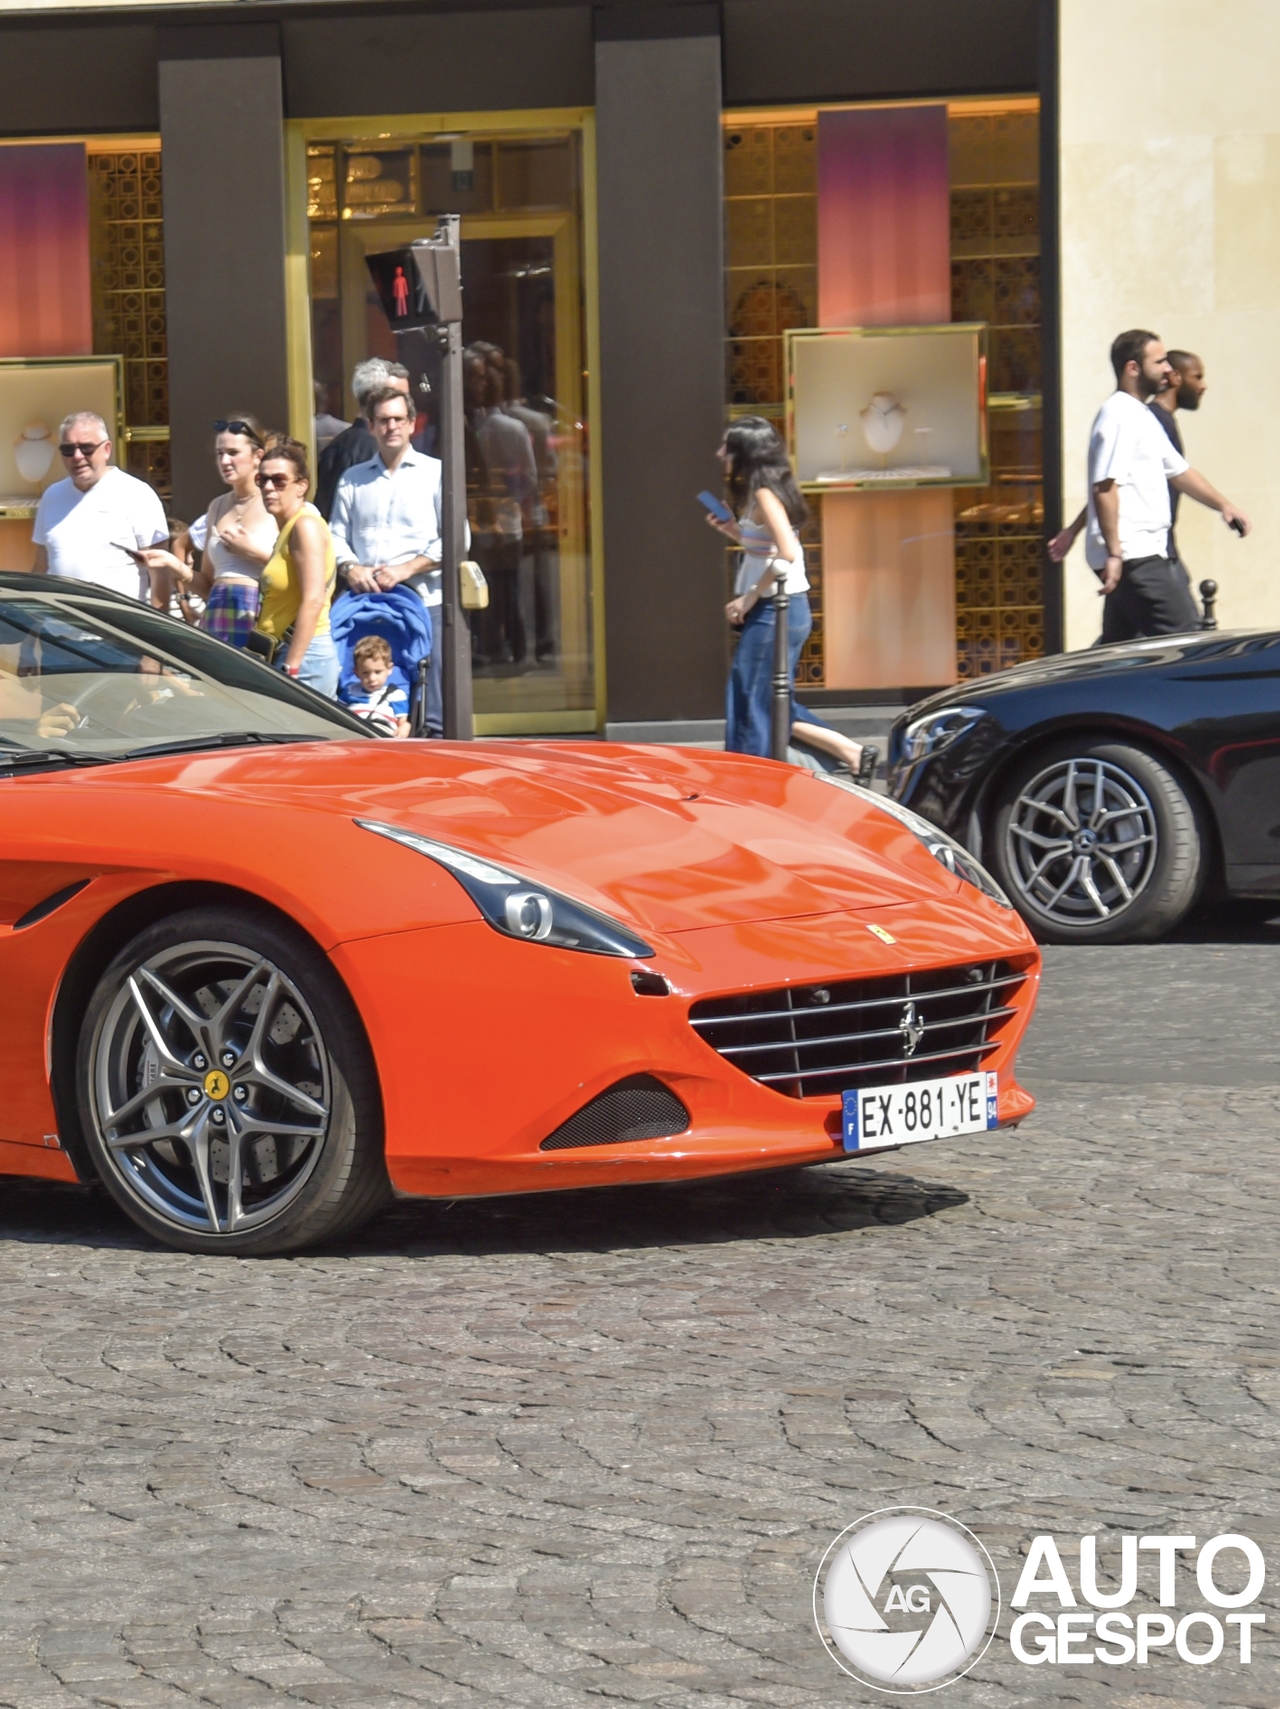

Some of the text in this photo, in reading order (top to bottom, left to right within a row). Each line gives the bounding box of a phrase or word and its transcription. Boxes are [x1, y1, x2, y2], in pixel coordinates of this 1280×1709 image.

[862, 1080, 981, 1138] EX-881-YE
[987, 1101, 997, 1119] 94
[848, 1123, 854, 1135] F
